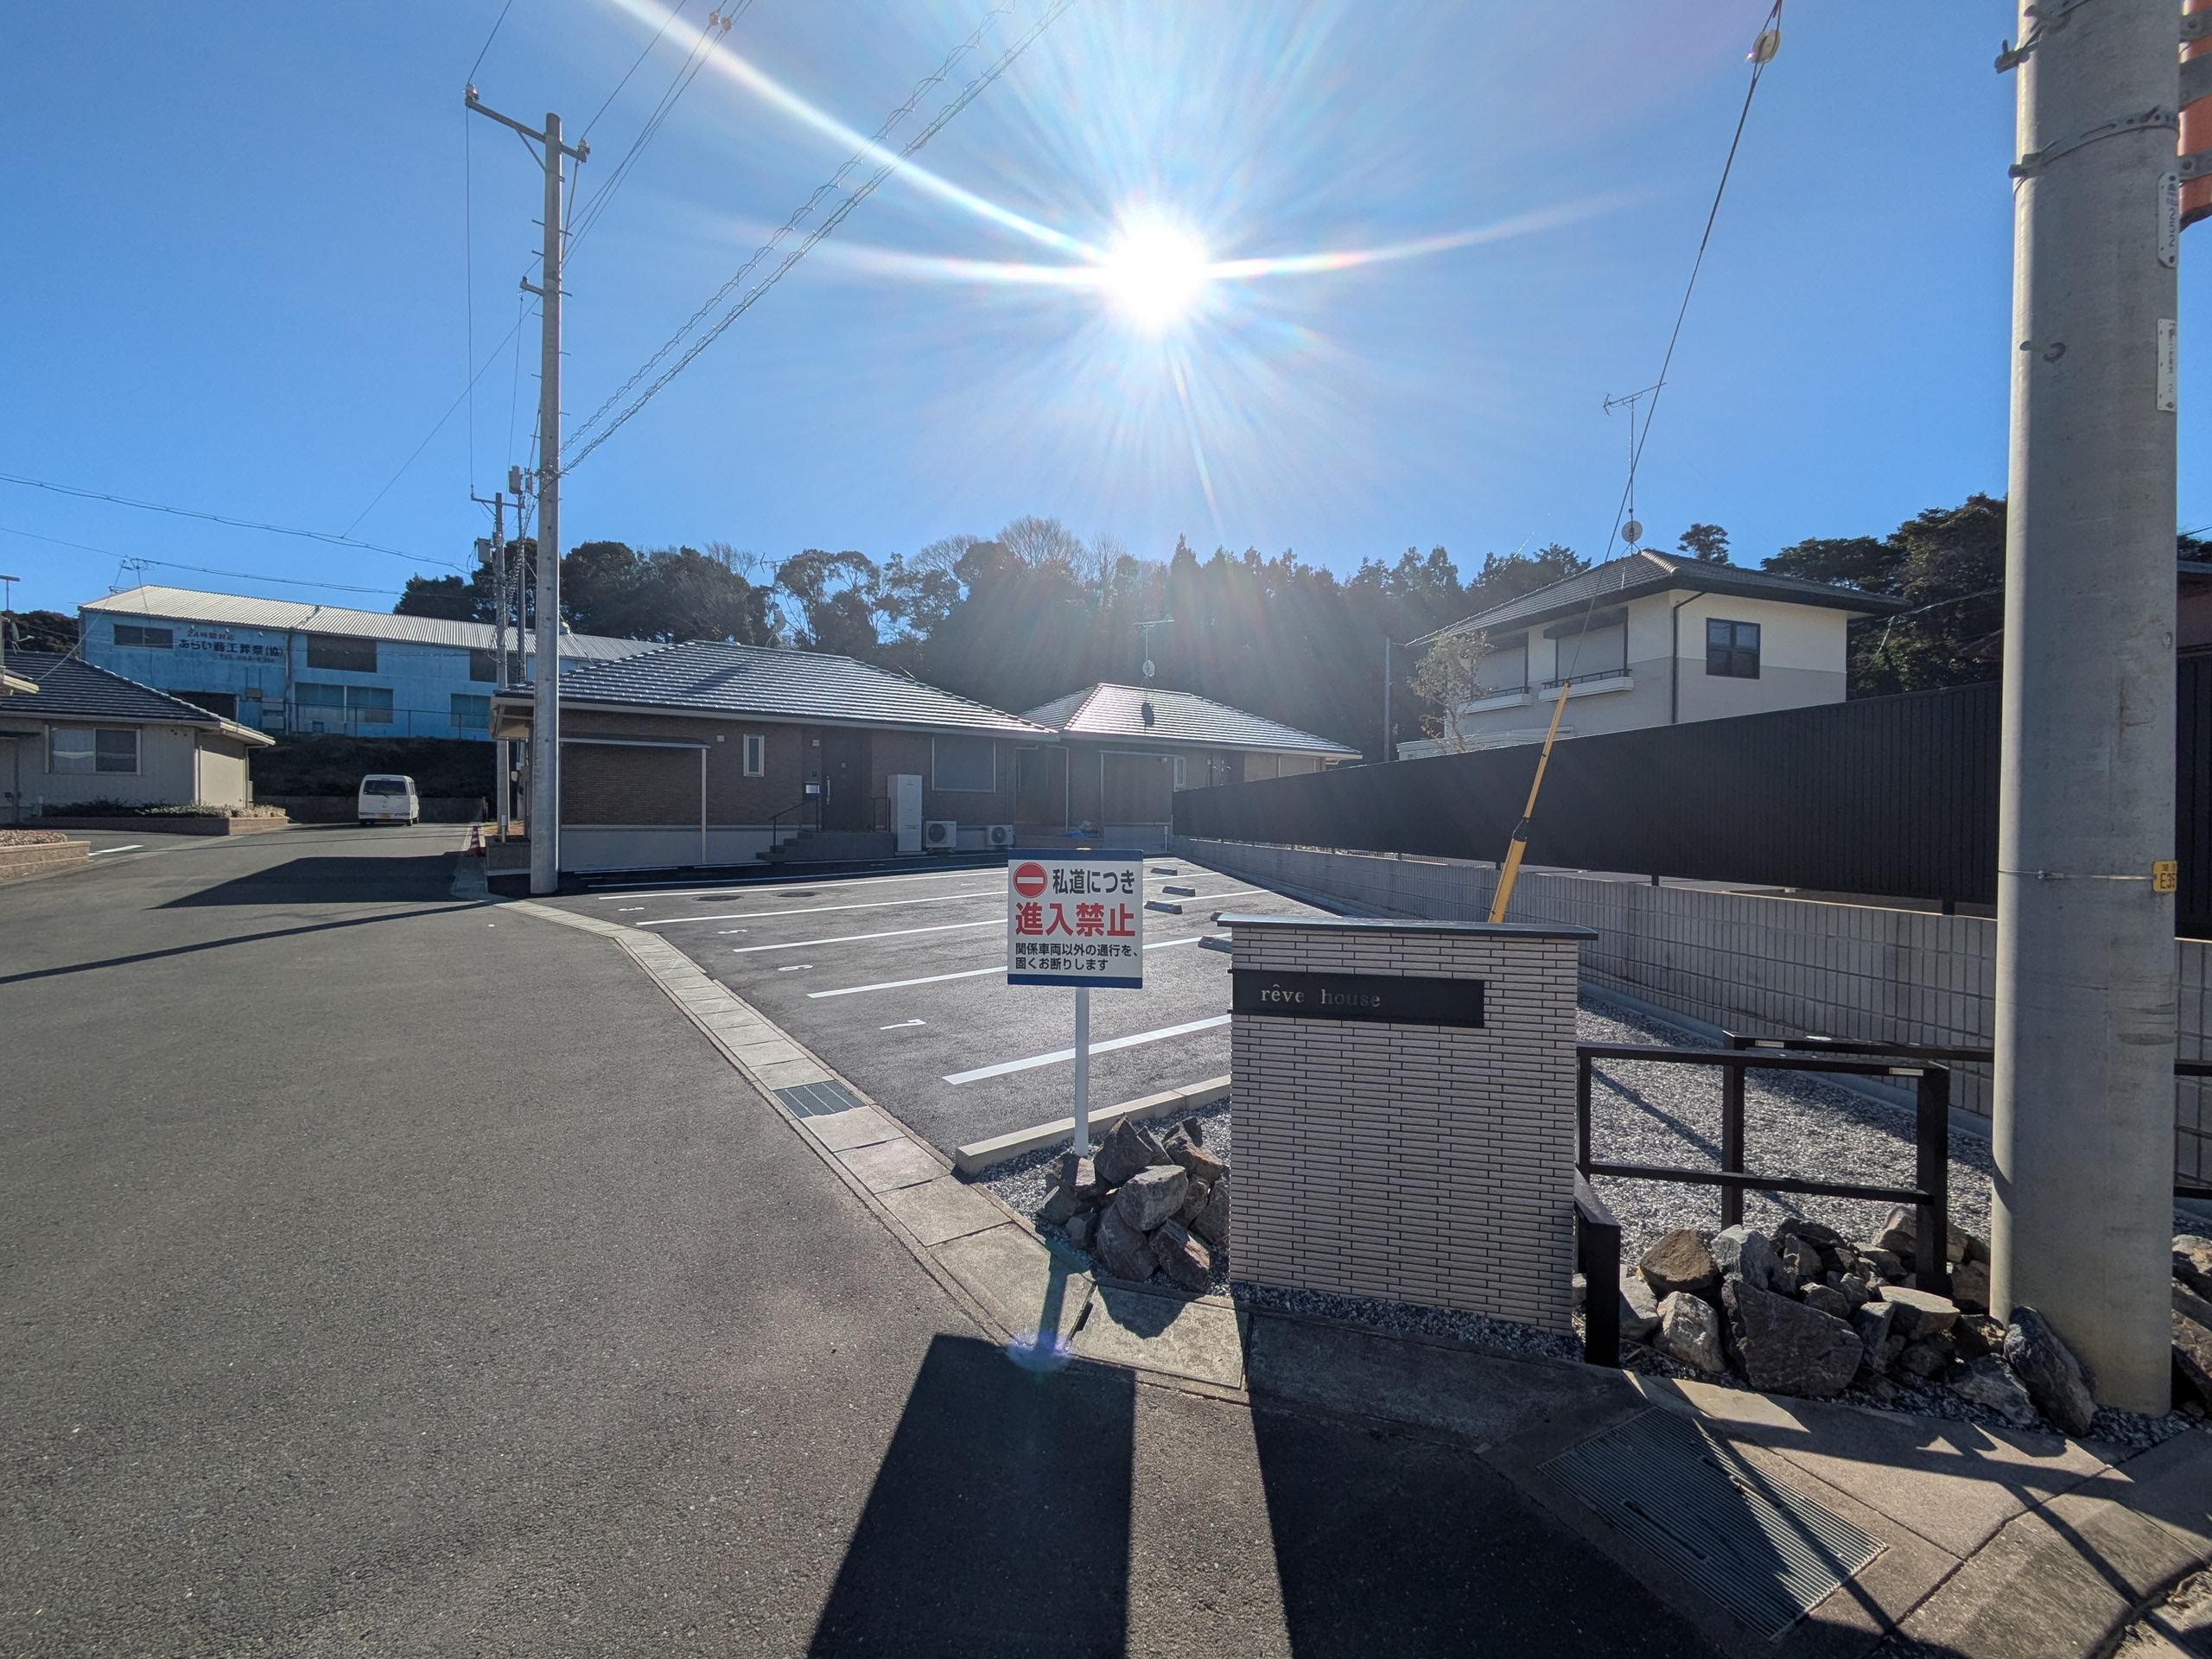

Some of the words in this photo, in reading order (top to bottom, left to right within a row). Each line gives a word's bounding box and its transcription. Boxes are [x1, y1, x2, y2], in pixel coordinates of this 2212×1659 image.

[1052, 868, 1135, 894] 私道につき
[1015, 902, 1136, 938] 進入禁止
[1015, 942, 1139, 958] 関係車両以外の通行を、
[1015, 957, 1109, 971] 固くお断りします
[1261, 984, 1305, 1003] rêve
[1321, 989, 1381, 1007] house
